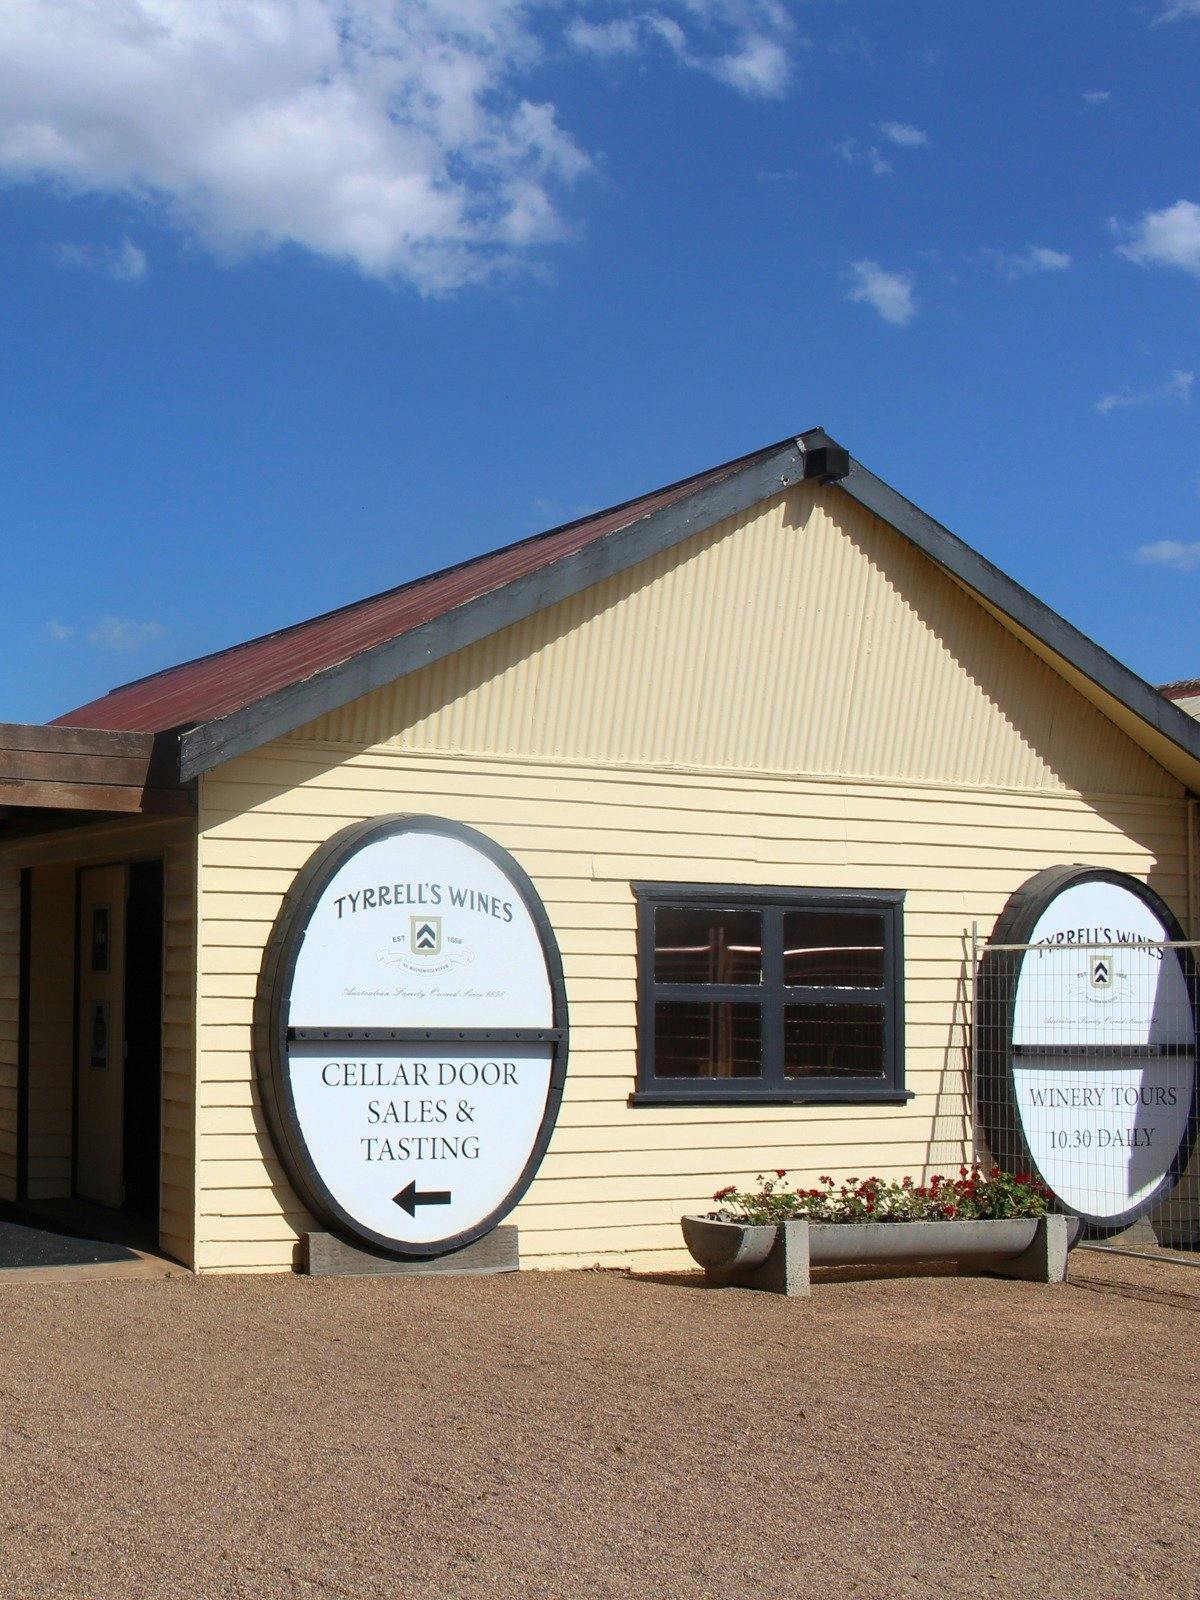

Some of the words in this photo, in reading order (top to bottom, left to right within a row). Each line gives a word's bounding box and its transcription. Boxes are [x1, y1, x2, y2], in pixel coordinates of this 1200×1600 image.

[333, 883, 442, 919] TYRRELL'S
[448, 886, 514, 923] WINES
[392, 935, 406, 943] EST
[1116, 929, 1164, 960] WINES
[341, 987, 390, 997] Australian
[393, 987, 425, 999] Family
[430, 987, 460, 998] Owned
[321, 1062, 429, 1087] CELLAR
[437, 1062, 520, 1087] DOOR
[1029, 1087, 1106, 1107] WINERY
[1111, 1086, 1177, 1106] TOURS
[367, 1099, 448, 1124] SALES
[455, 1099, 476, 1123] &
[360, 1136, 481, 1161] TASTING
[1050, 1129, 1092, 1149] 10.30
[1097, 1128, 1156, 1148] DAILY
